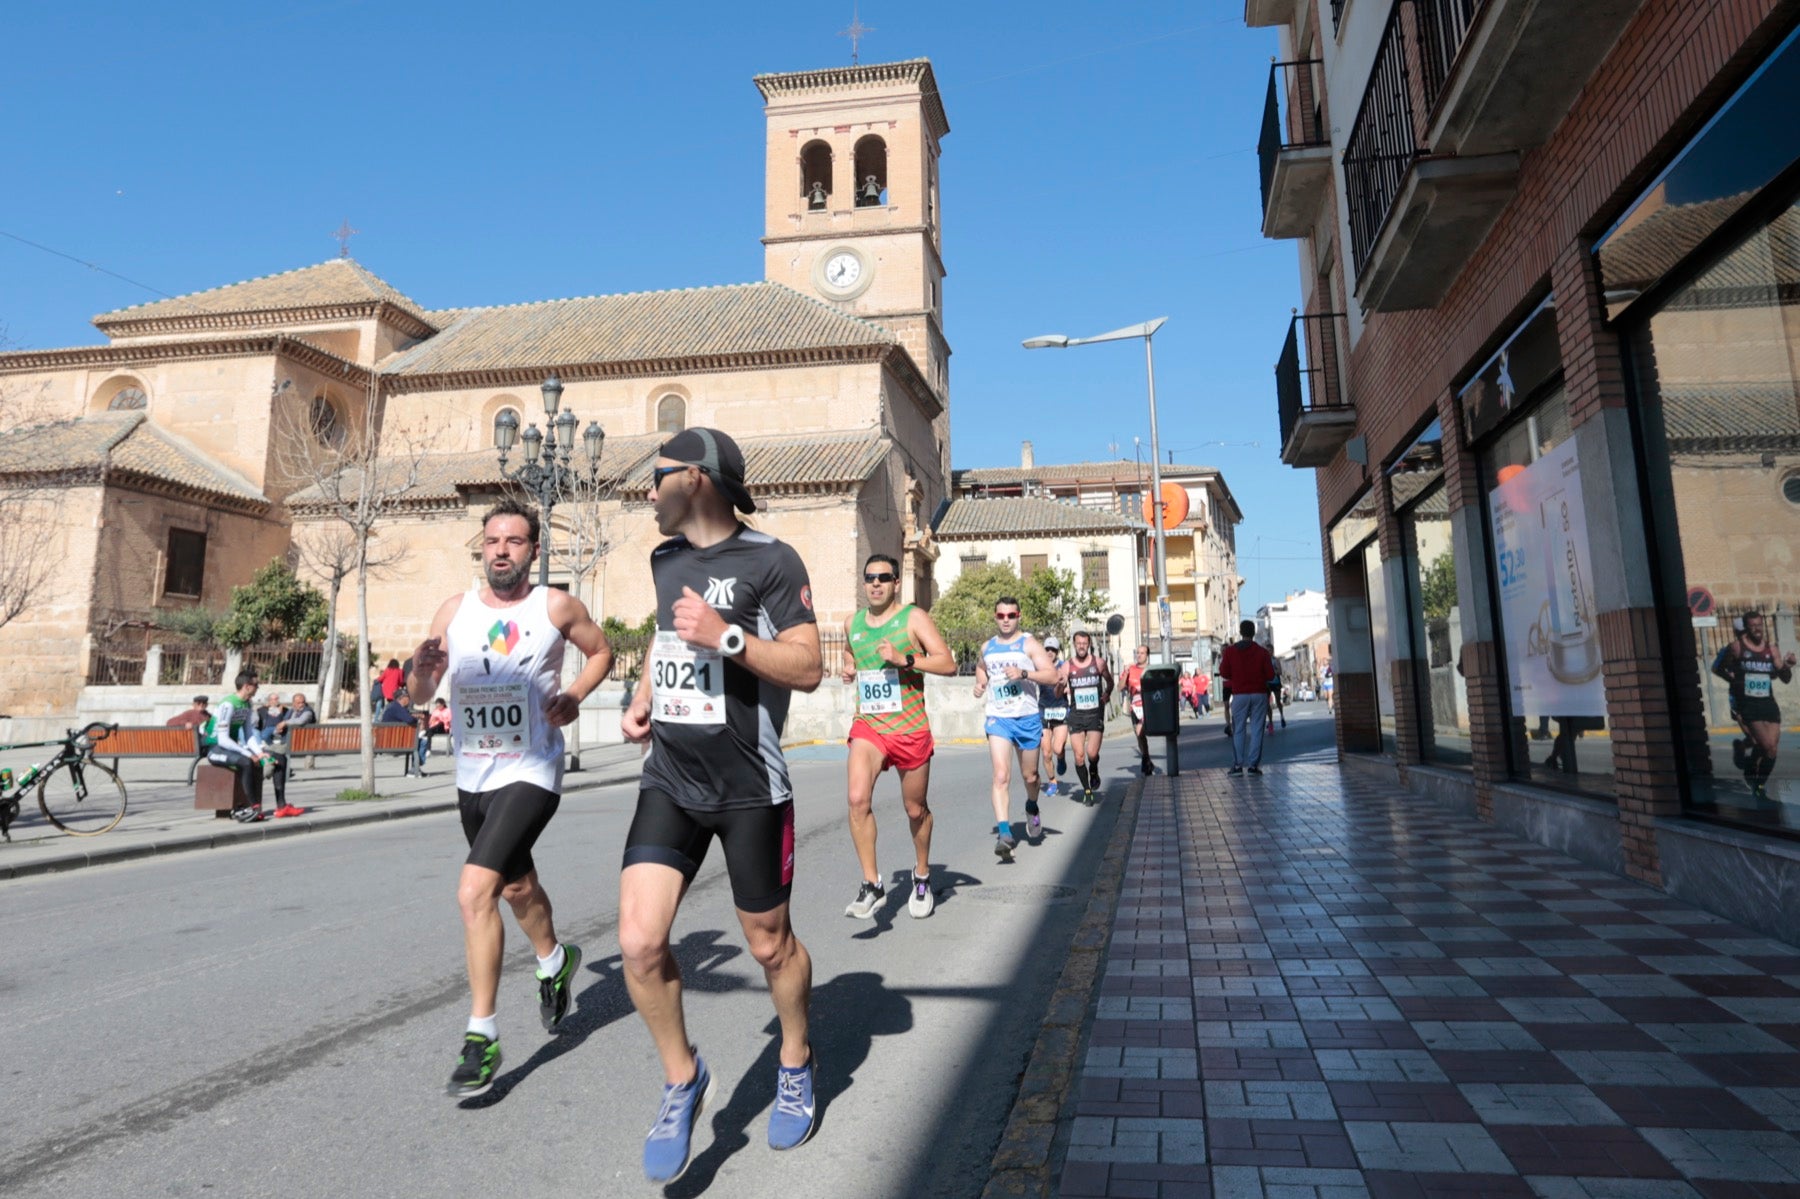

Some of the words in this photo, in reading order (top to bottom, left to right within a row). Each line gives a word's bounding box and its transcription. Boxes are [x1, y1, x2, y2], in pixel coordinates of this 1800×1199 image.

[655, 660, 711, 690] 3021
[864, 683, 892, 699] 869
[998, 684, 1018, 698] 198
[464, 704, 522, 729] 3100
